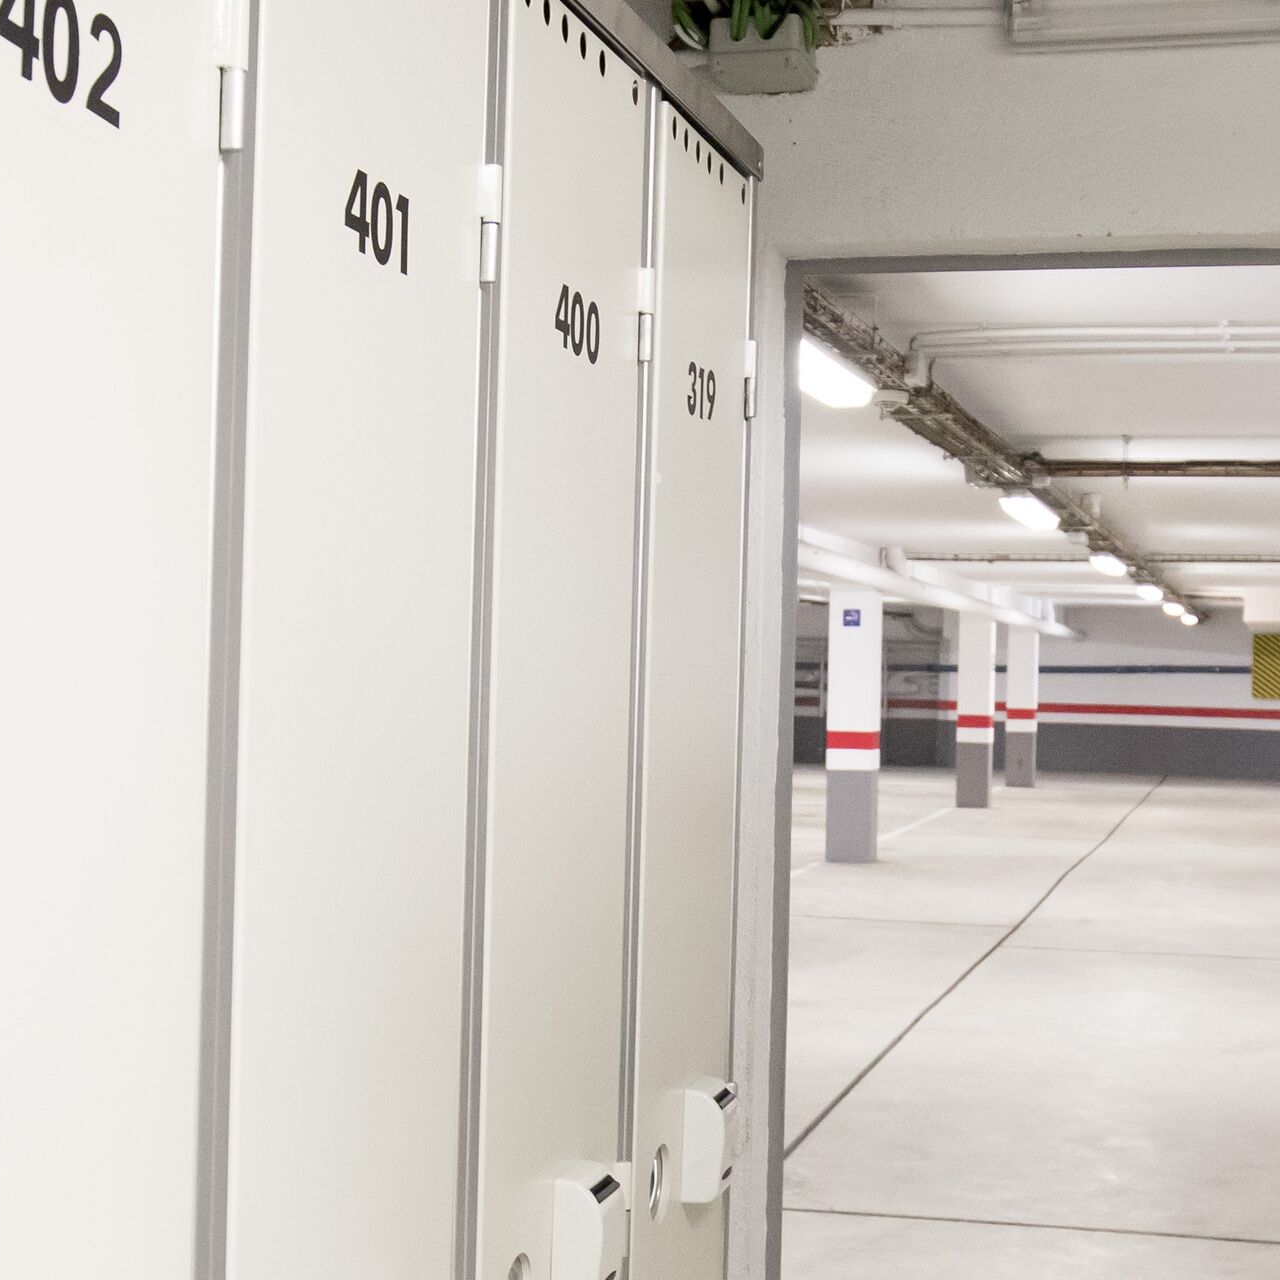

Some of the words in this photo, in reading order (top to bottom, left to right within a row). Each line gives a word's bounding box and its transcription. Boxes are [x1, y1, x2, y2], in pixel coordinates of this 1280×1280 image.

[344, 169, 410, 276] 401
[555, 283, 601, 365] 400
[687, 361, 717, 421] 319
